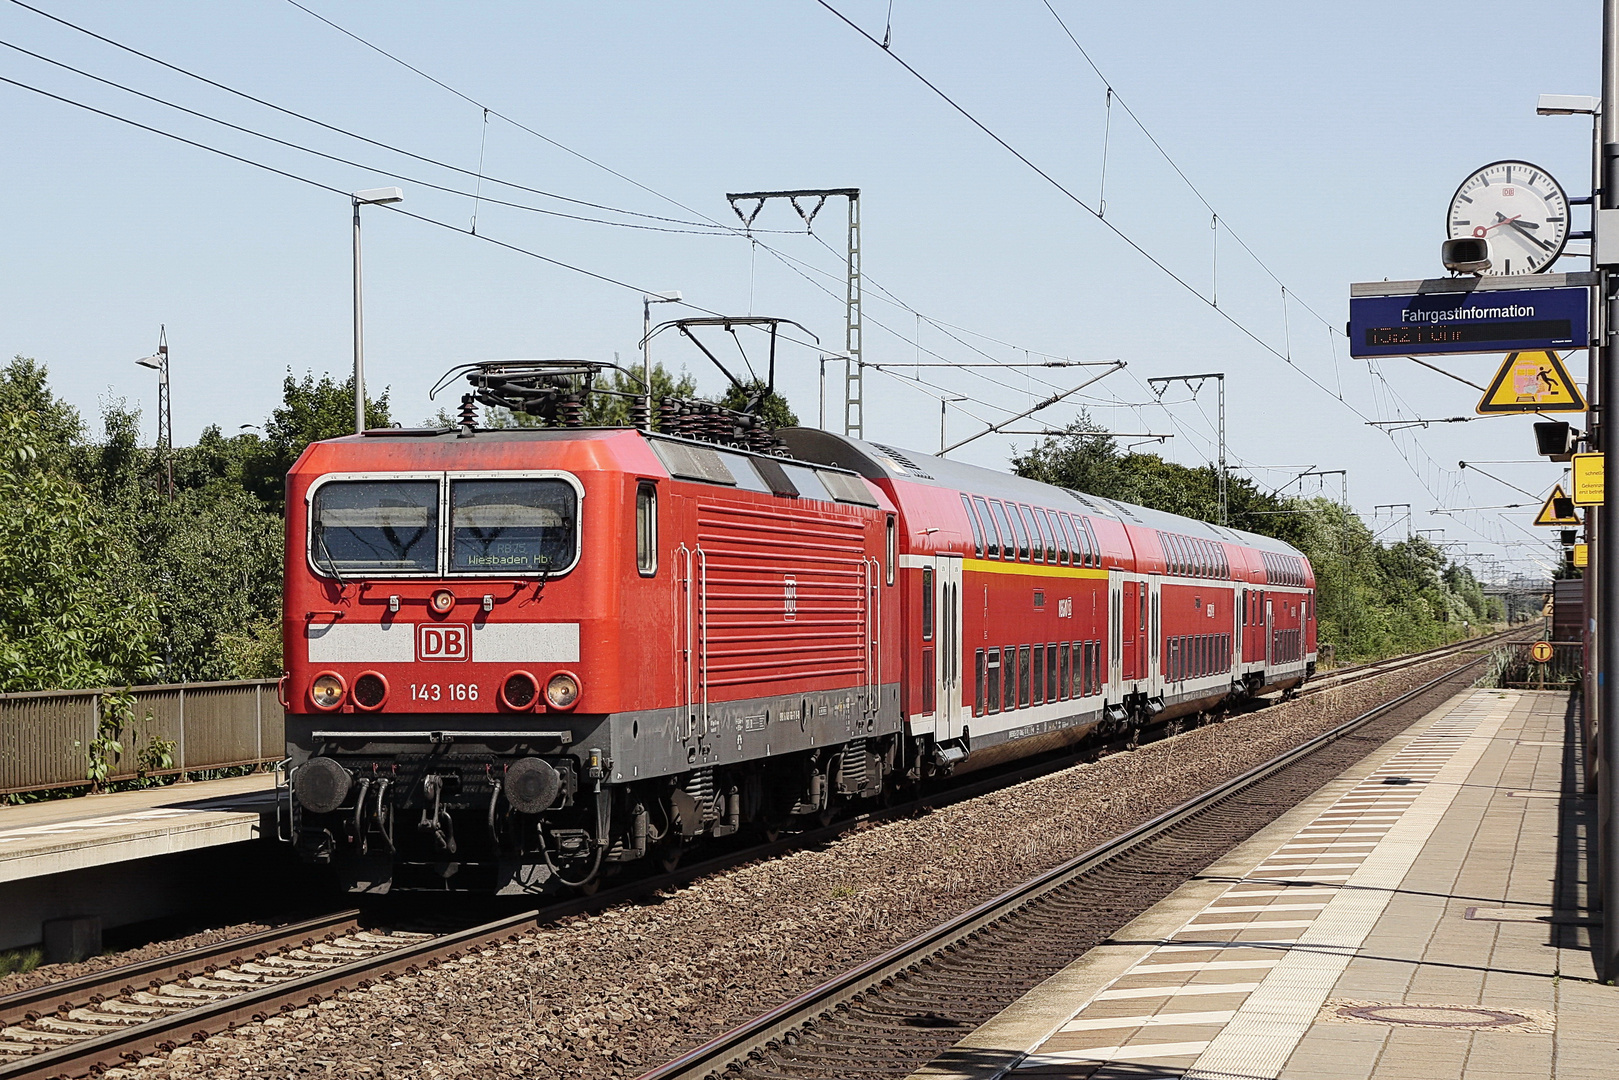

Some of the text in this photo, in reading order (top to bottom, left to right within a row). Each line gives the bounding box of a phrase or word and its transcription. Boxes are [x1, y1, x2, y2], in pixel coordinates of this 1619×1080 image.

[1401, 304, 1535, 323] Fahrgastinformation
[468, 555, 528, 566] Wiesbaden
[424, 630, 463, 656] DB
[410, 683, 479, 701] 143 166
